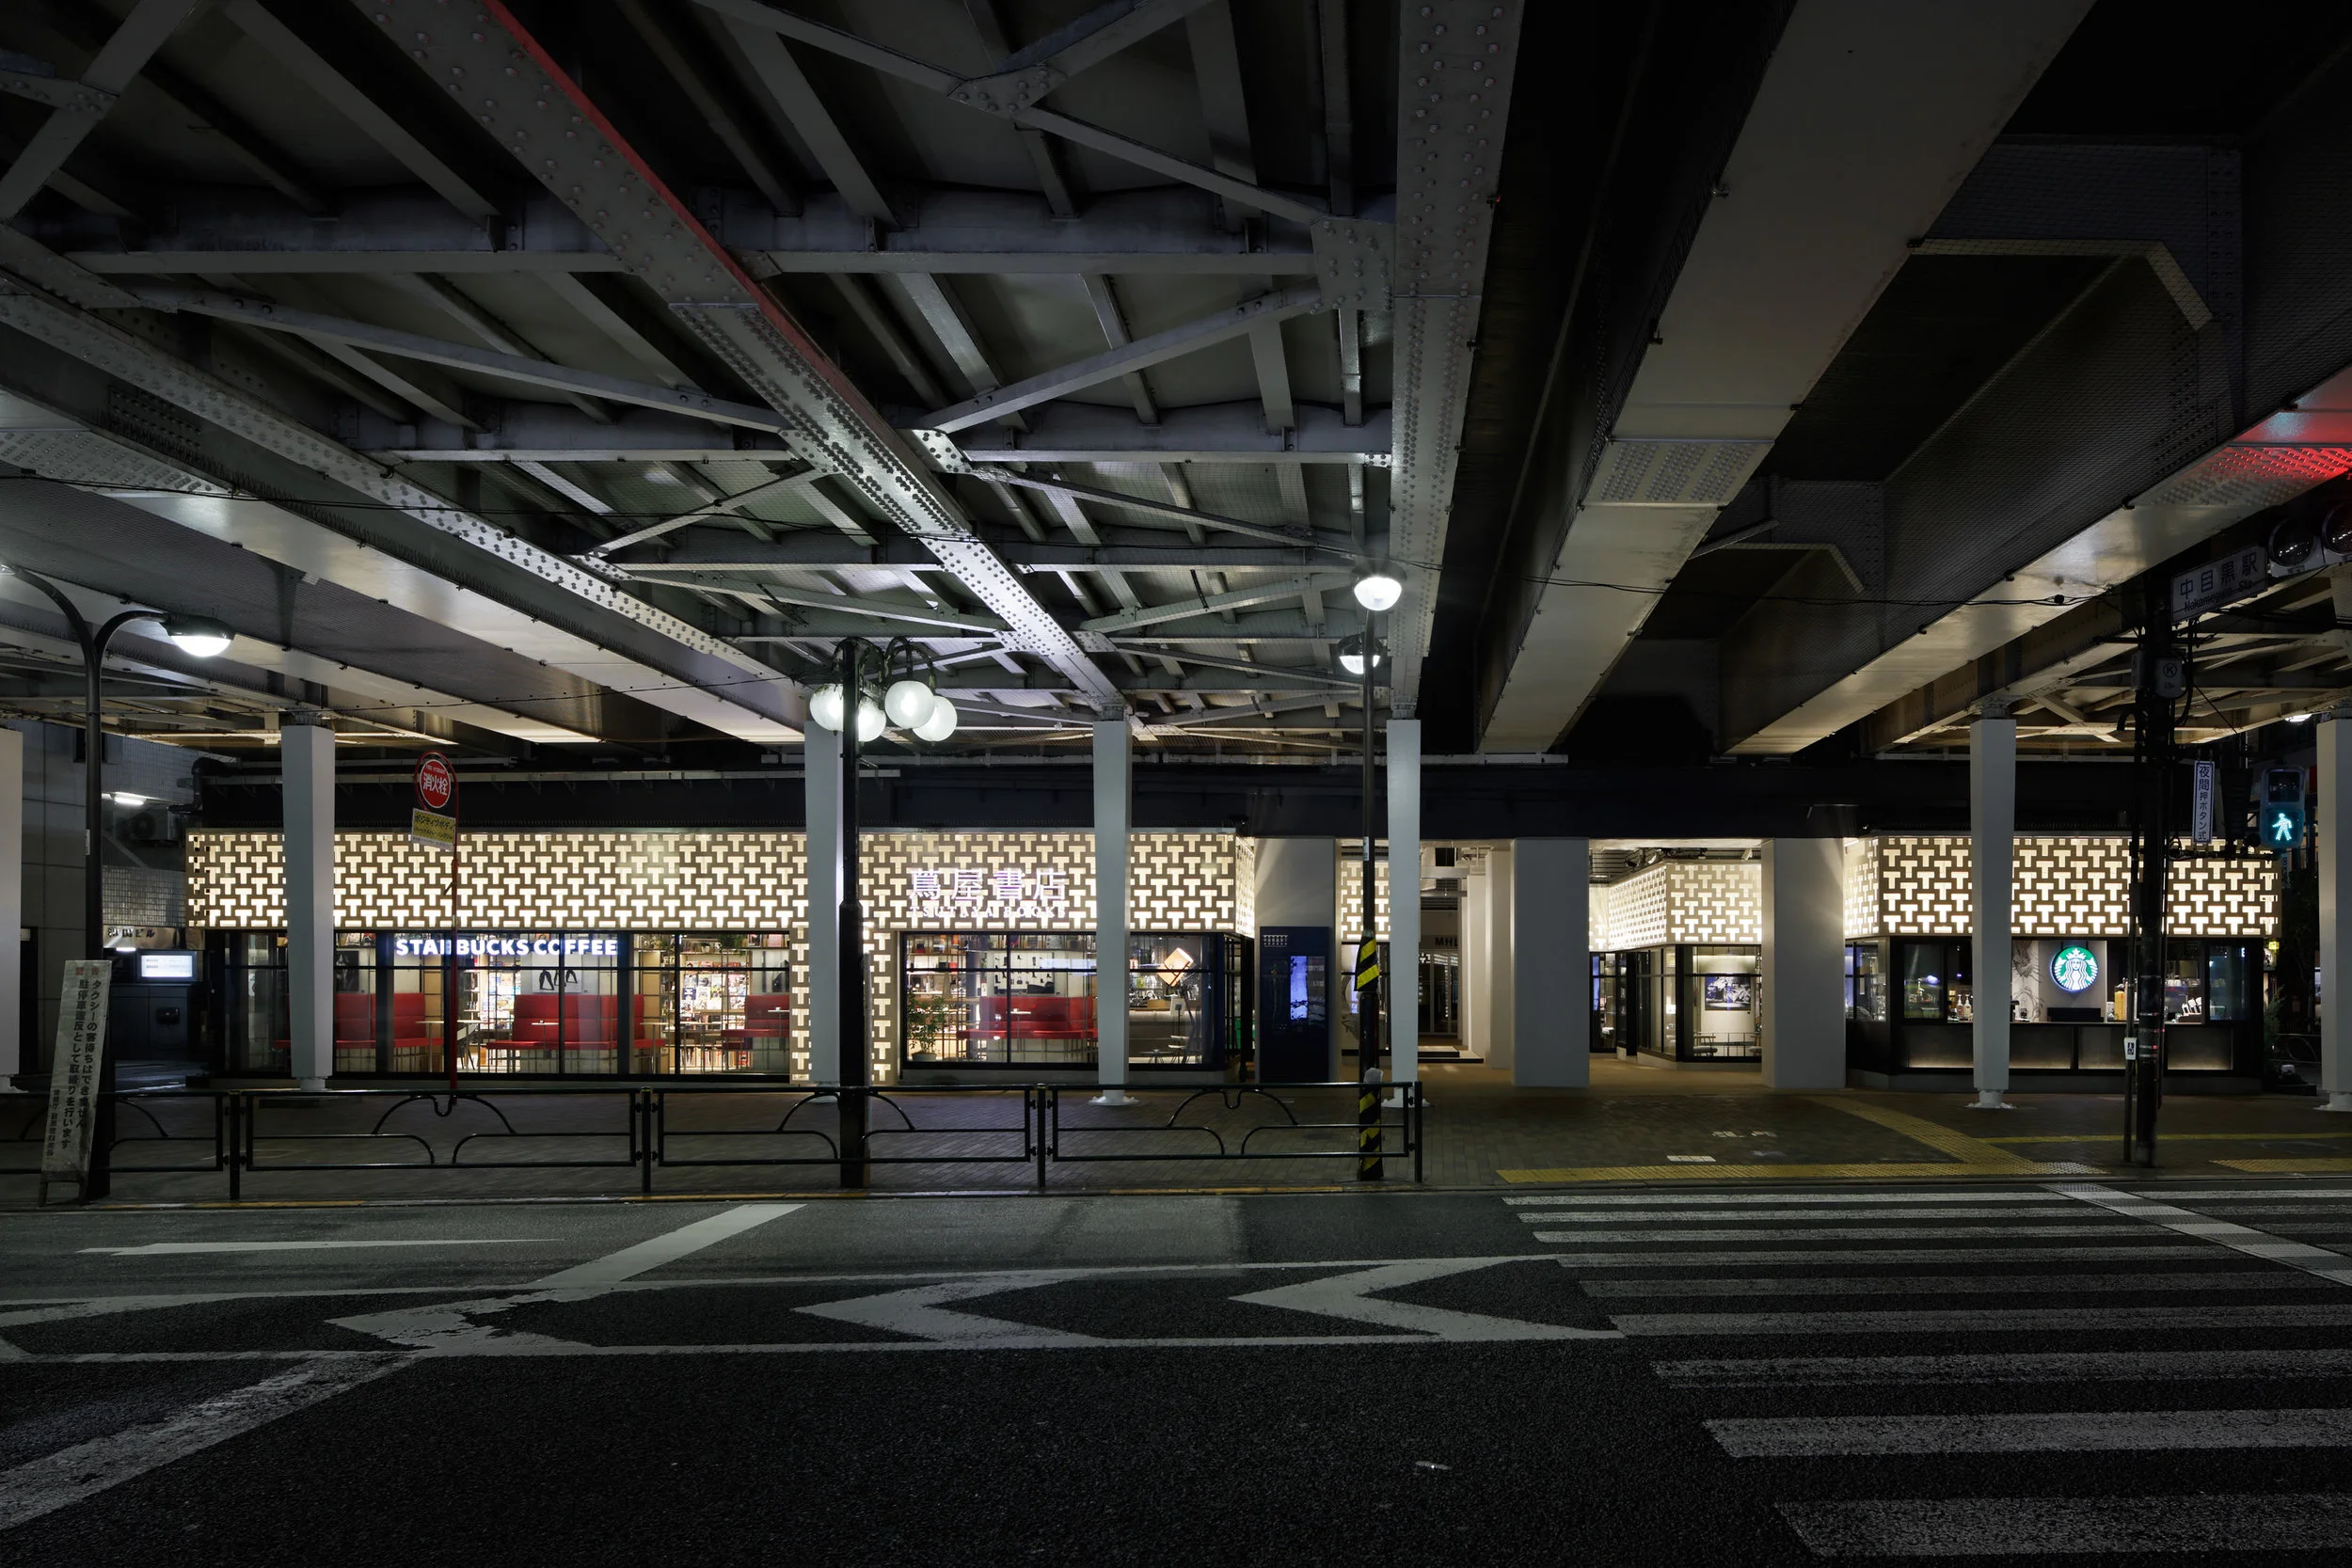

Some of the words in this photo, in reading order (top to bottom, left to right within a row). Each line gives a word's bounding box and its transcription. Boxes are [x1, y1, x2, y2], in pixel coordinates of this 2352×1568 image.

[2180, 552, 2257, 599] 中目黒駅
[422, 772, 448, 796] 消火栓
[2198, 766, 2210, 840] 夜間押ボタン式
[909, 867, 1067, 900] 蔦屋書店
[910, 906, 993, 918] TSUTAYA
[1004, 906, 1065, 918] BOOKS
[533, 939, 618, 956] COFFEE
